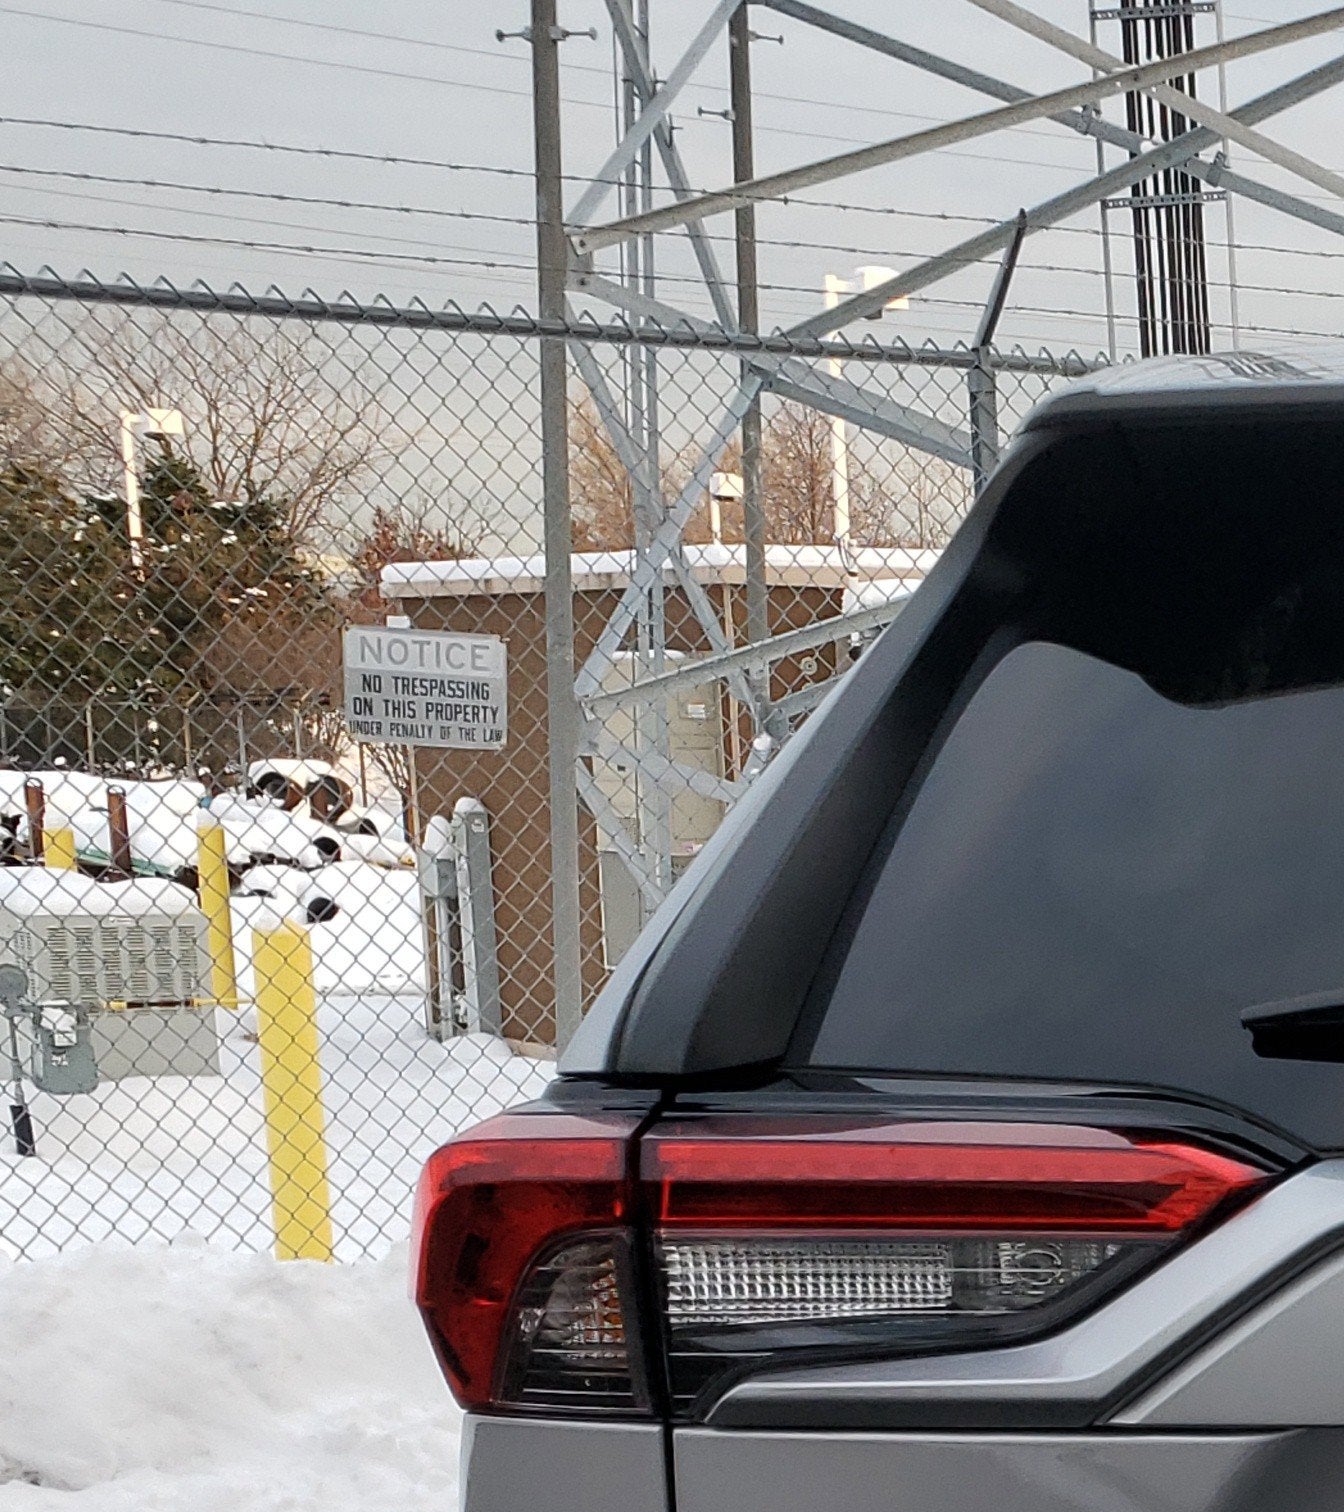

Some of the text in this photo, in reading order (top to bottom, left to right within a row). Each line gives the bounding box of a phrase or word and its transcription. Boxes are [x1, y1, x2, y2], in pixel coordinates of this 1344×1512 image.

[359, 636, 491, 671] NOTICE
[361, 674, 490, 700] NO TRESPASSING
[353, 697, 499, 724] ON THIS PROPERTY
[349, 721, 503, 743] UNDER PENALTY OF THE LAW
